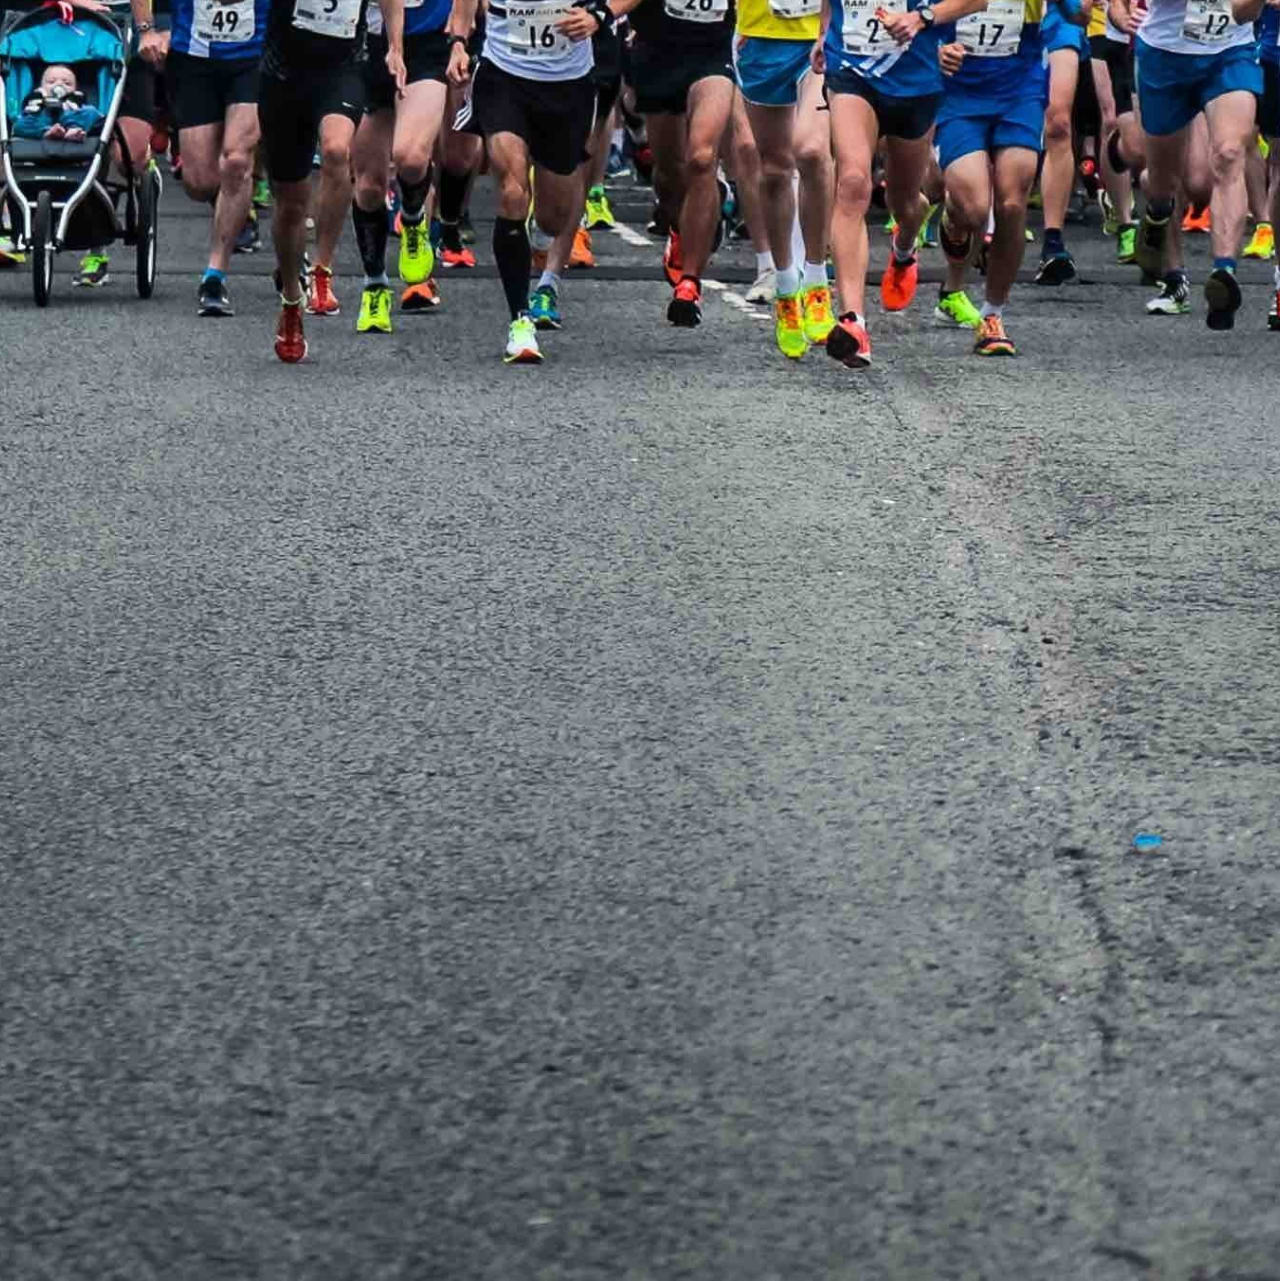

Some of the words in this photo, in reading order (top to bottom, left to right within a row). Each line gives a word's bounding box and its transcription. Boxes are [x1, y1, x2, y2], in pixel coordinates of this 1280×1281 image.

[211, 9, 239, 33] 49
[866, 18, 880, 44] 2
[529, 24, 556, 49] 16
[978, 23, 1005, 46] 17
